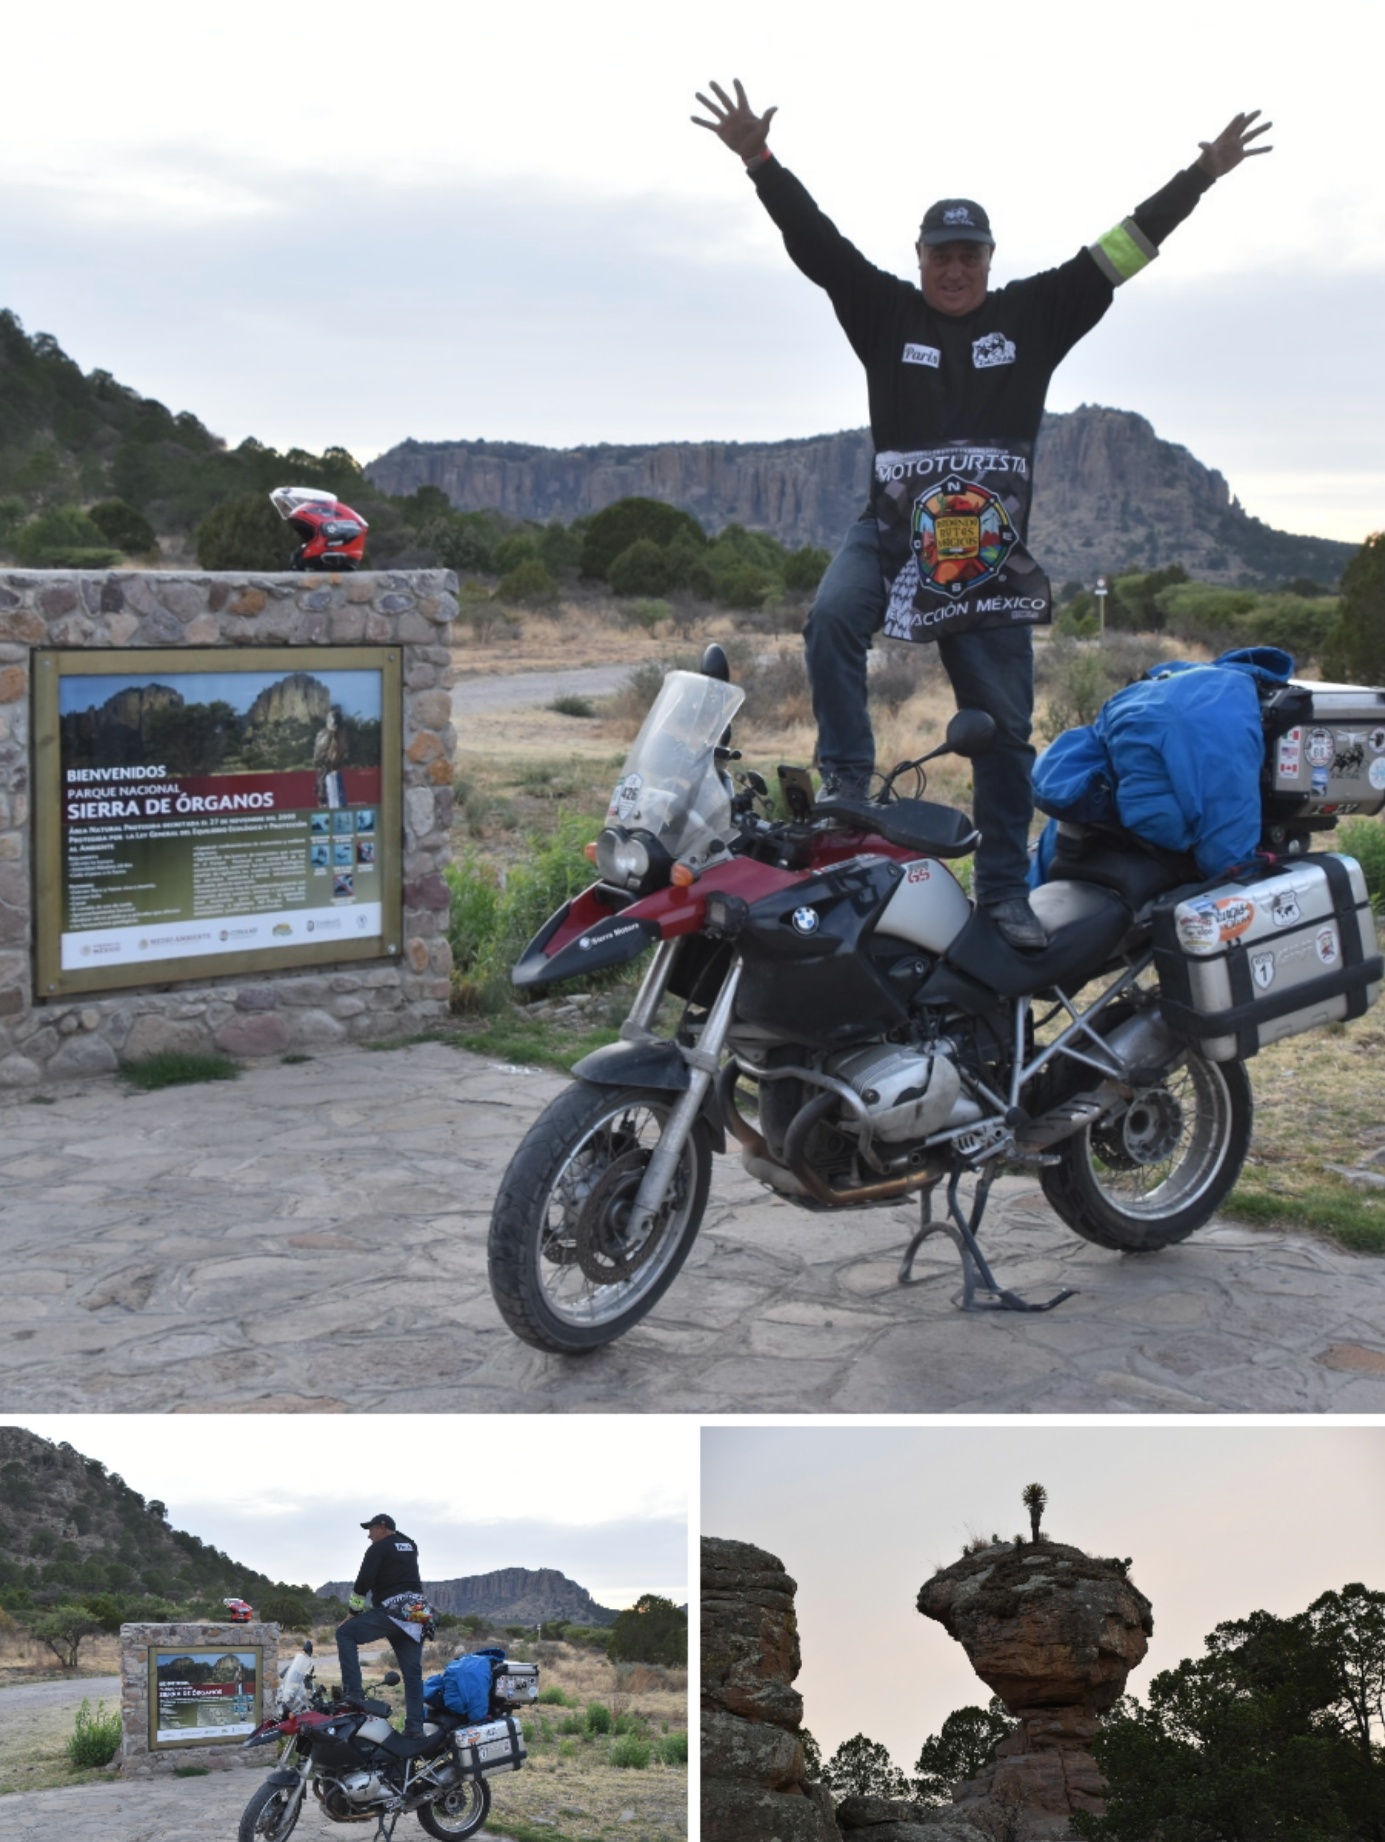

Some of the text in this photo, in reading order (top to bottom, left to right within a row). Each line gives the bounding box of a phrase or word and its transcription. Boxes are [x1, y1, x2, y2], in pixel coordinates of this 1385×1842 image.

[905, 346, 938, 364] Paris
[878, 454, 1026, 482] MOTOTURISTA
[947, 481, 960, 492] N
[911, 602, 969, 626] ACCIÓN
[976, 595, 1046, 613] MÉXICO
[67, 765, 166, 782] BIENVENIDOS
[68, 784, 180, 799] PARQUE NACIONAL
[621, 787, 639, 801] 426
[67, 792, 274, 820] SIERRA DE ÓRGANOS
[908, 870, 931, 884] GS
[591, 922, 640, 946] Sierra Motors
[1259, 965, 1268, 982] 1
